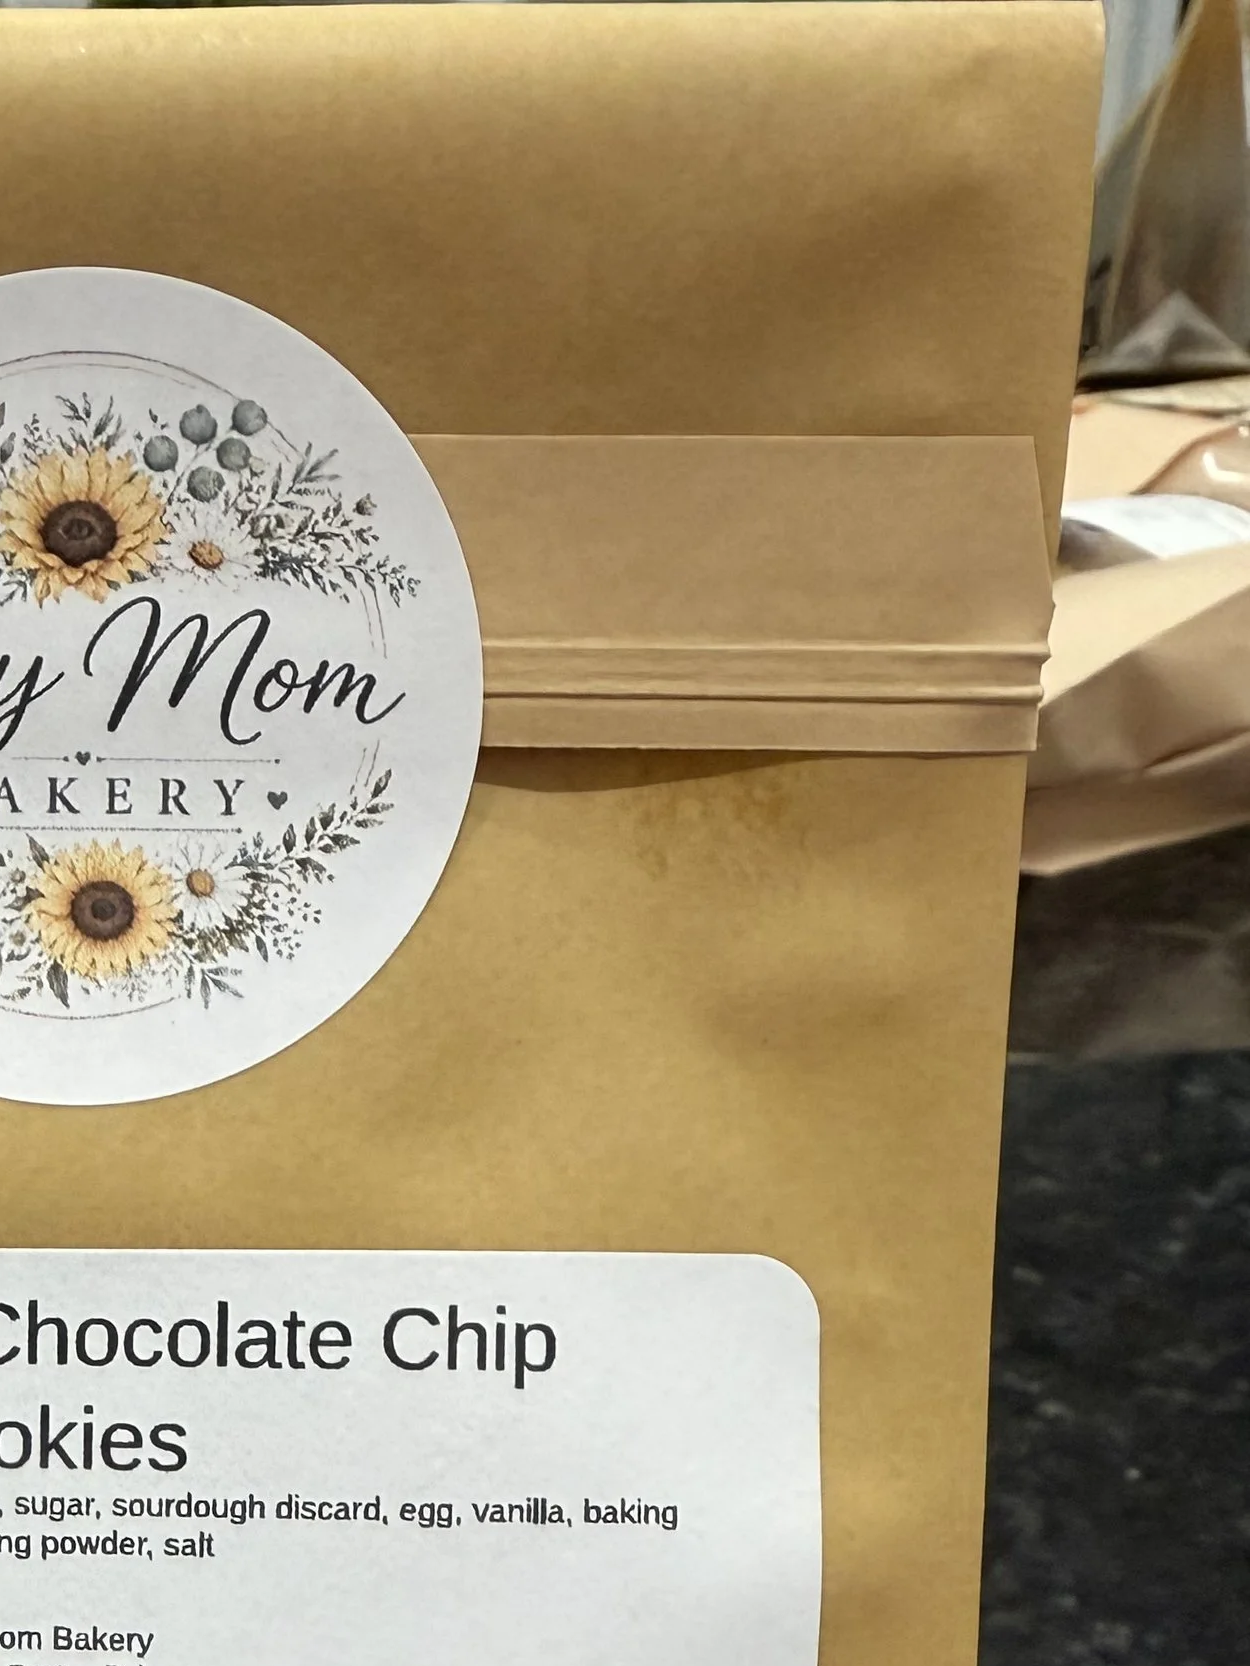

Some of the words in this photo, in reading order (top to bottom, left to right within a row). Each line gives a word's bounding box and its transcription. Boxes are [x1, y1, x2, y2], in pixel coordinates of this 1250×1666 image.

[82, 594, 409, 747] Mom
[381, 1303, 558, 1392] Chip
[13, 1494, 103, 1524] sugar,
[110, 1490, 267, 1527] sourdough
[274, 1491, 390, 1527] discard,
[397, 1501, 463, 1530] egg,
[469, 1495, 574, 1529] vanilla,
[582, 1496, 679, 1532] baking
[39, 1528, 154, 1563] powder,
[162, 1529, 217, 1560] salt
[52, 1624, 156, 1660] Bakery
